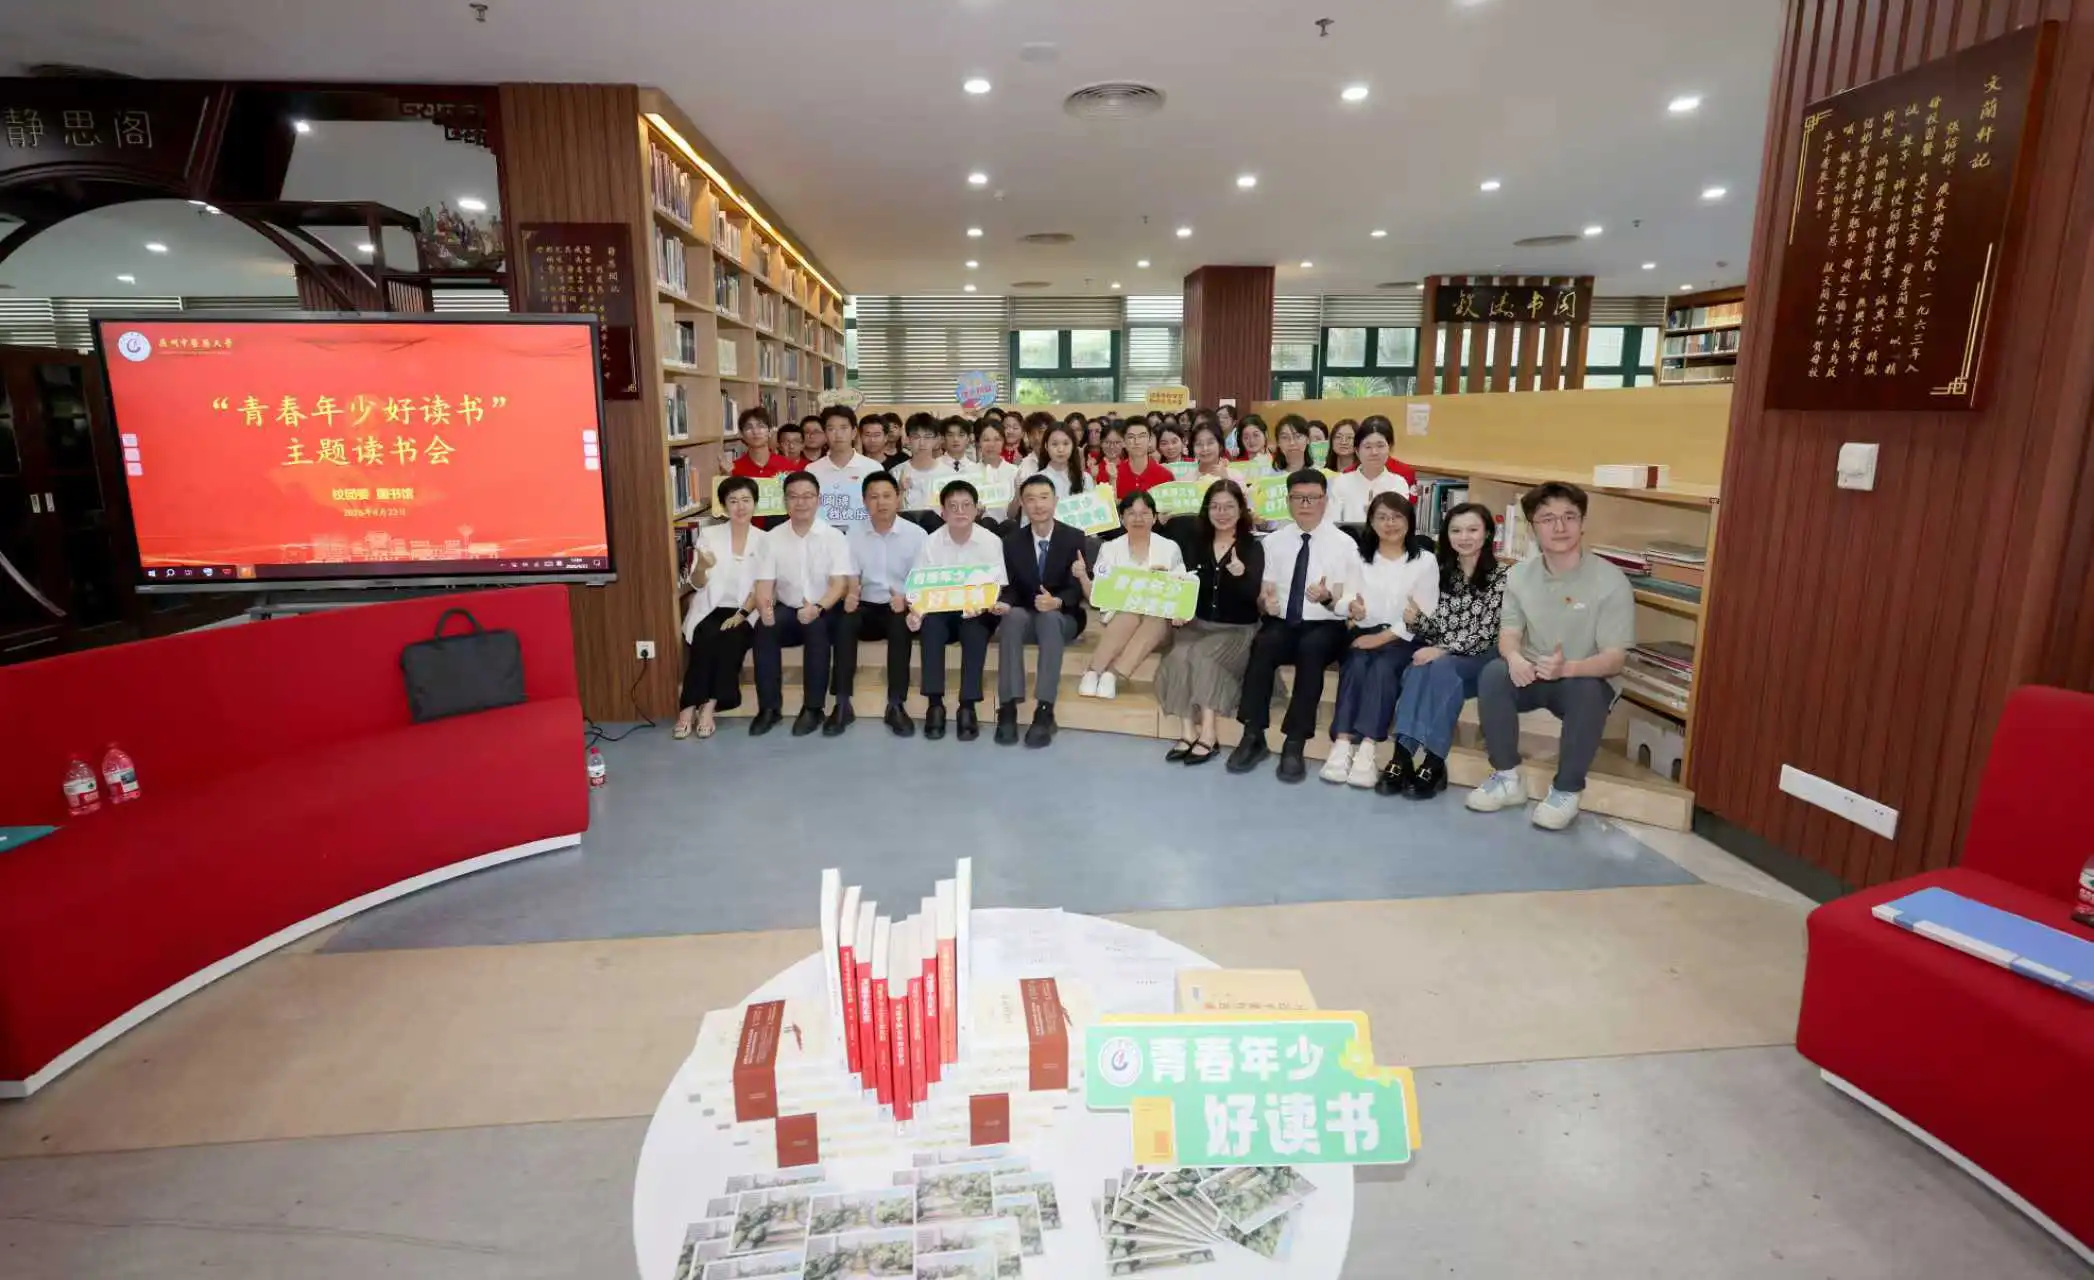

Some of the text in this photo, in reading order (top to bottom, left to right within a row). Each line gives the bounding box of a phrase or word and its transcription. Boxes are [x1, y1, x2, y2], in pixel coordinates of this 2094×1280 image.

[281, 435, 456, 466] 主题读书会
[1148, 1033, 1325, 1083] 青春年少
[1203, 1092, 1380, 1157] 好读书
